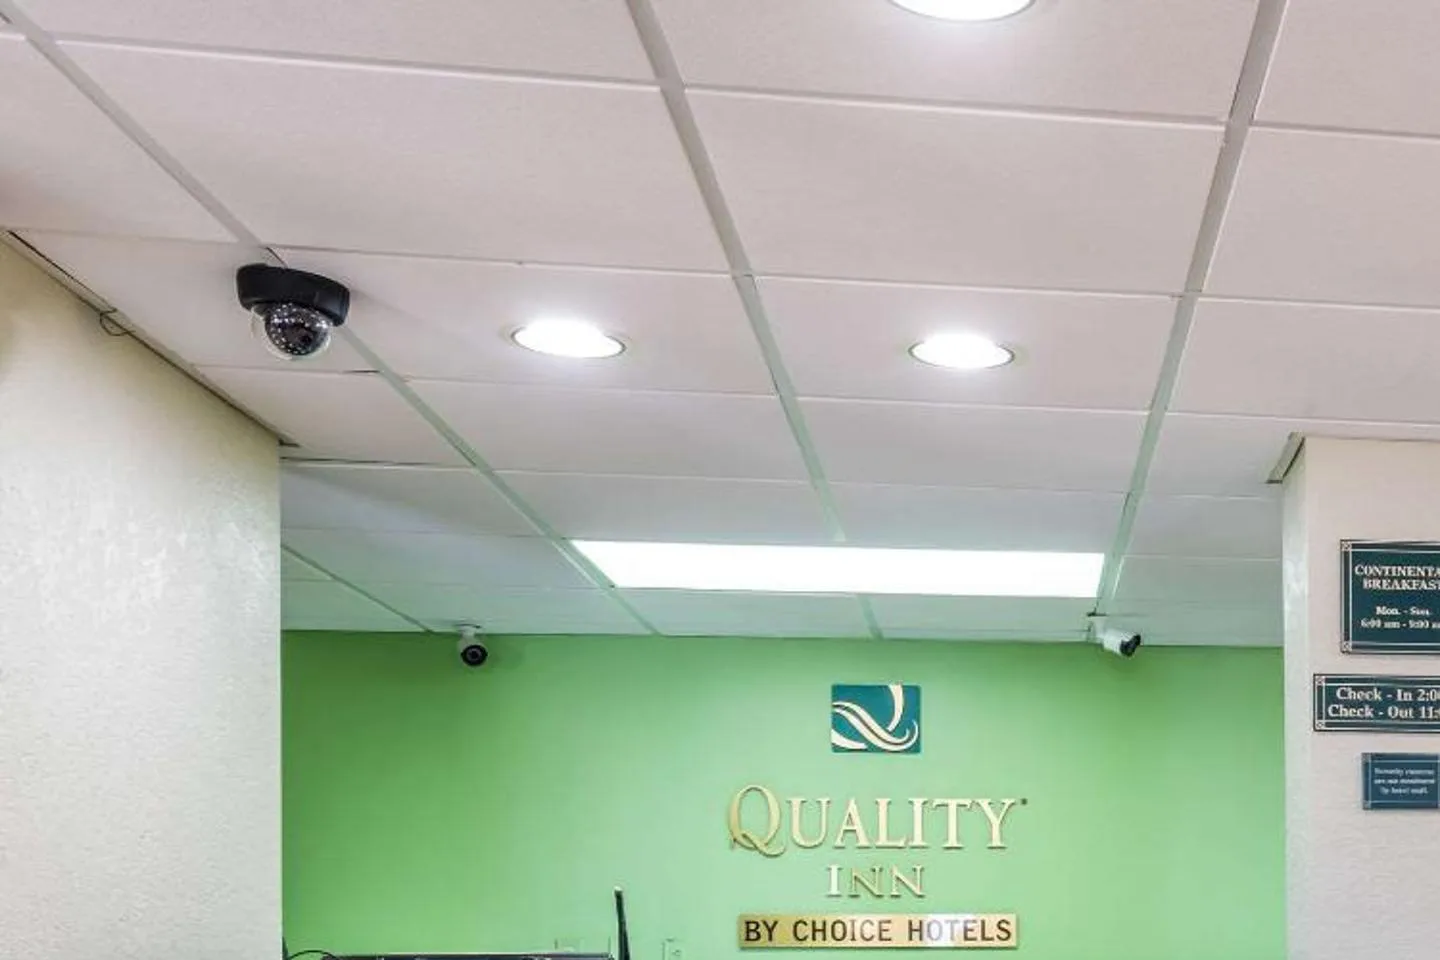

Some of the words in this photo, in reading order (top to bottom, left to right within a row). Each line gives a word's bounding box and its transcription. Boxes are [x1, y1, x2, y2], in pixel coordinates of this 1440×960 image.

[1335, 686, 1383, 701] Check
[1396, 689, 1413, 701] In
[1327, 703, 1375, 718] Check
[1387, 705, 1414, 719] Out
[727, 784, 1016, 858] QUALITY
[826, 863, 926, 898] INN
[744, 920, 779, 943] BY
[792, 919, 892, 943] CHOICE
[907, 919, 1012, 943] HOTELS
